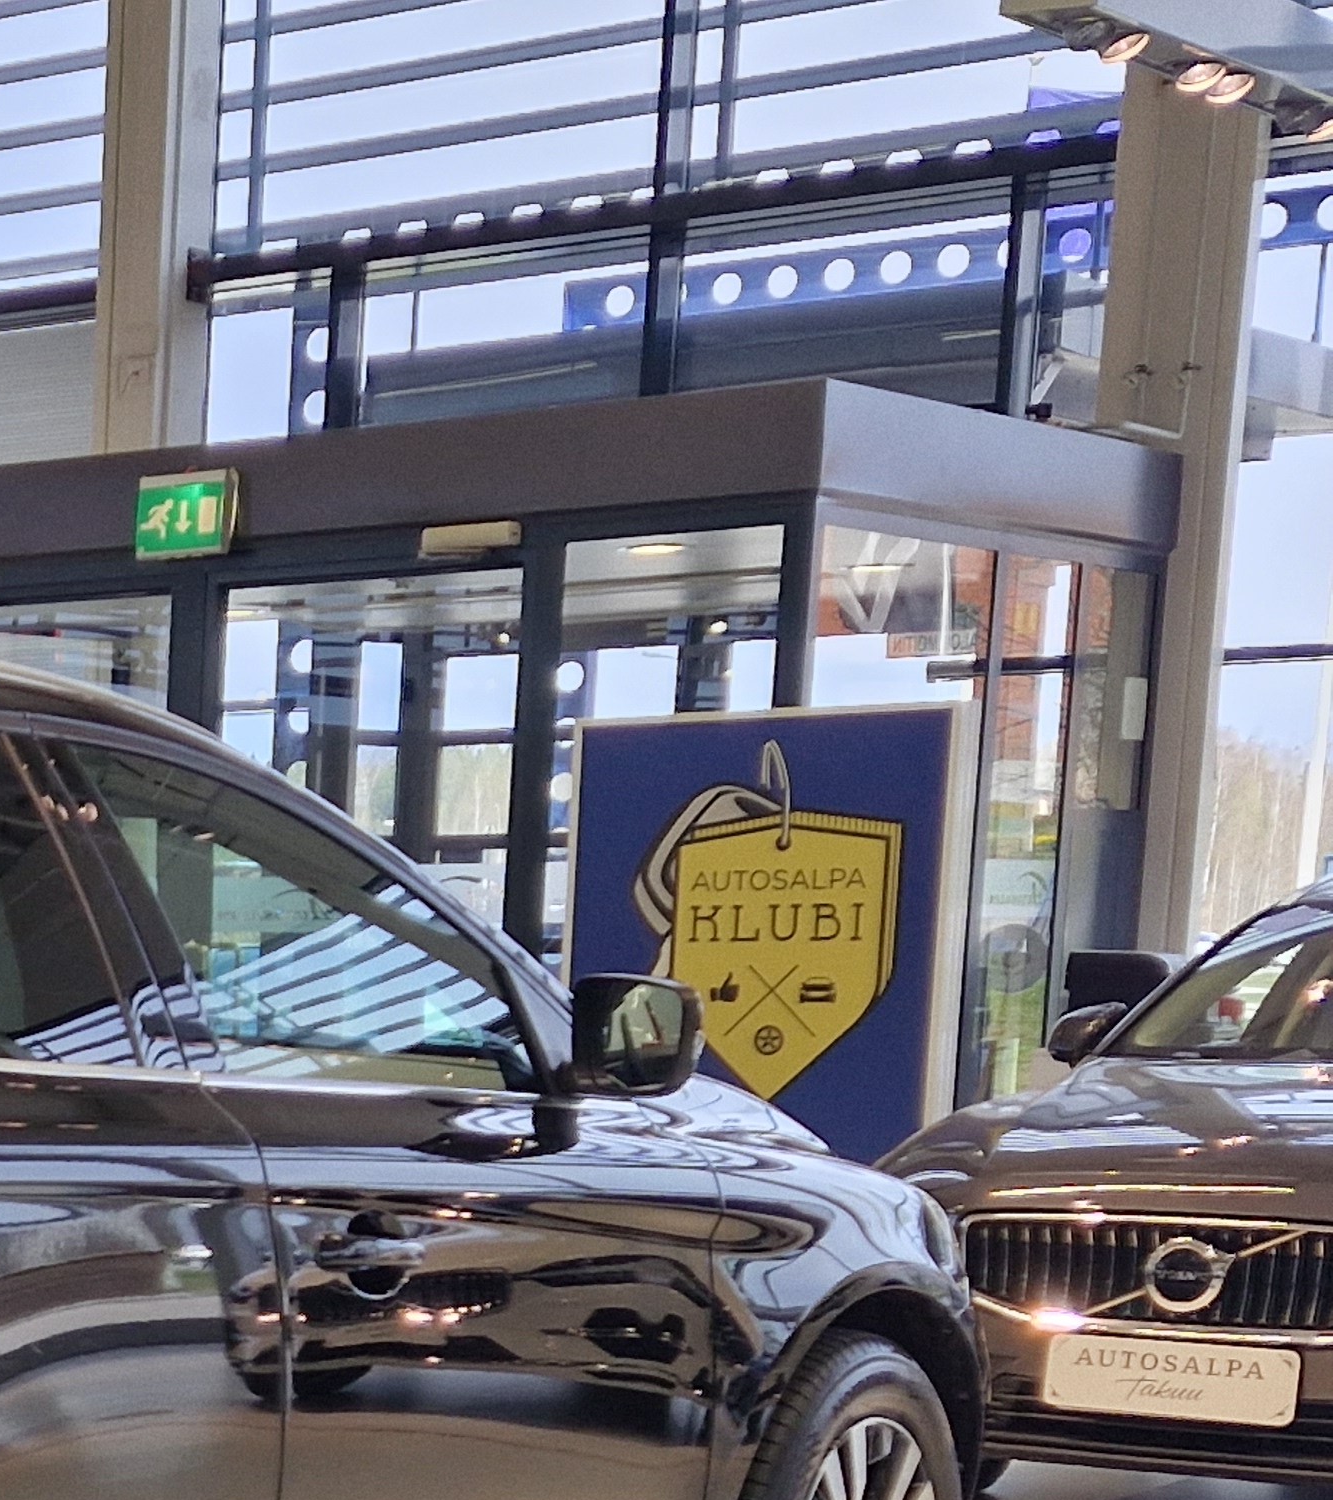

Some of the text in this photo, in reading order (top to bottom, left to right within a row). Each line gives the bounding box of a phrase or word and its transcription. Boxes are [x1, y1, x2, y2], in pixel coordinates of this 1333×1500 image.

[691, 868, 866, 892] AUTOSALPA
[688, 903, 865, 942] KLUBI
[1074, 1348, 1265, 1381] AUTOSALPA
[1115, 1376, 1204, 1401] Takuu
